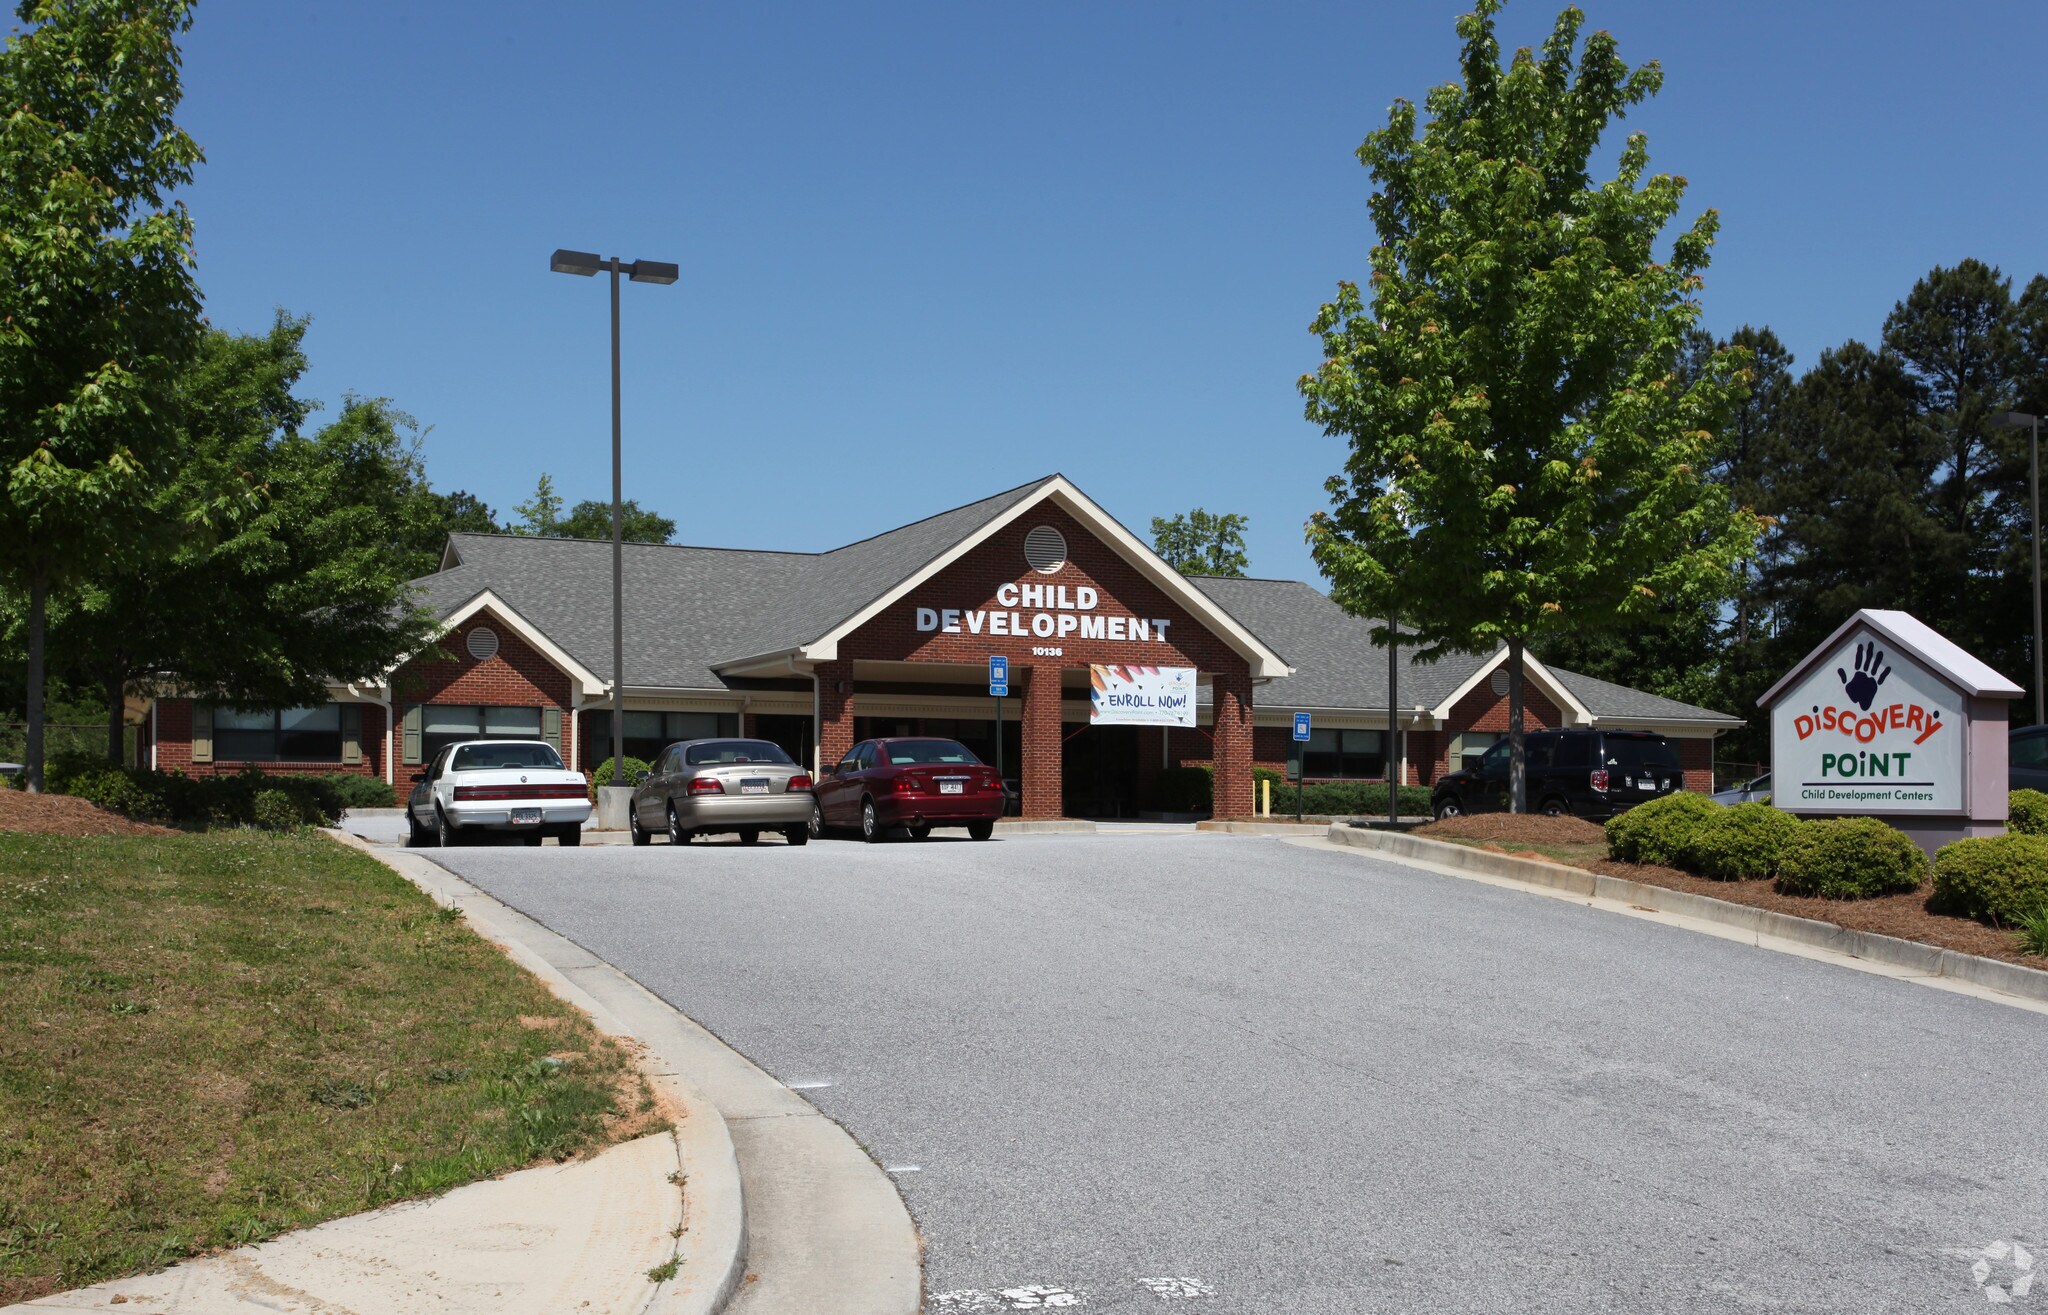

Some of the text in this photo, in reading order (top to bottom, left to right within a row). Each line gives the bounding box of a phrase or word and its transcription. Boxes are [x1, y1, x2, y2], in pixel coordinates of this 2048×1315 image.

[996, 583, 1098, 610] CHILD
[916, 607, 1171, 642] DEVELOPMENT
[1032, 646, 1063, 657] 10136
[1108, 693, 1187, 709] ENROLL NOW!
[1801, 789, 1934, 802] Child Development Centers
